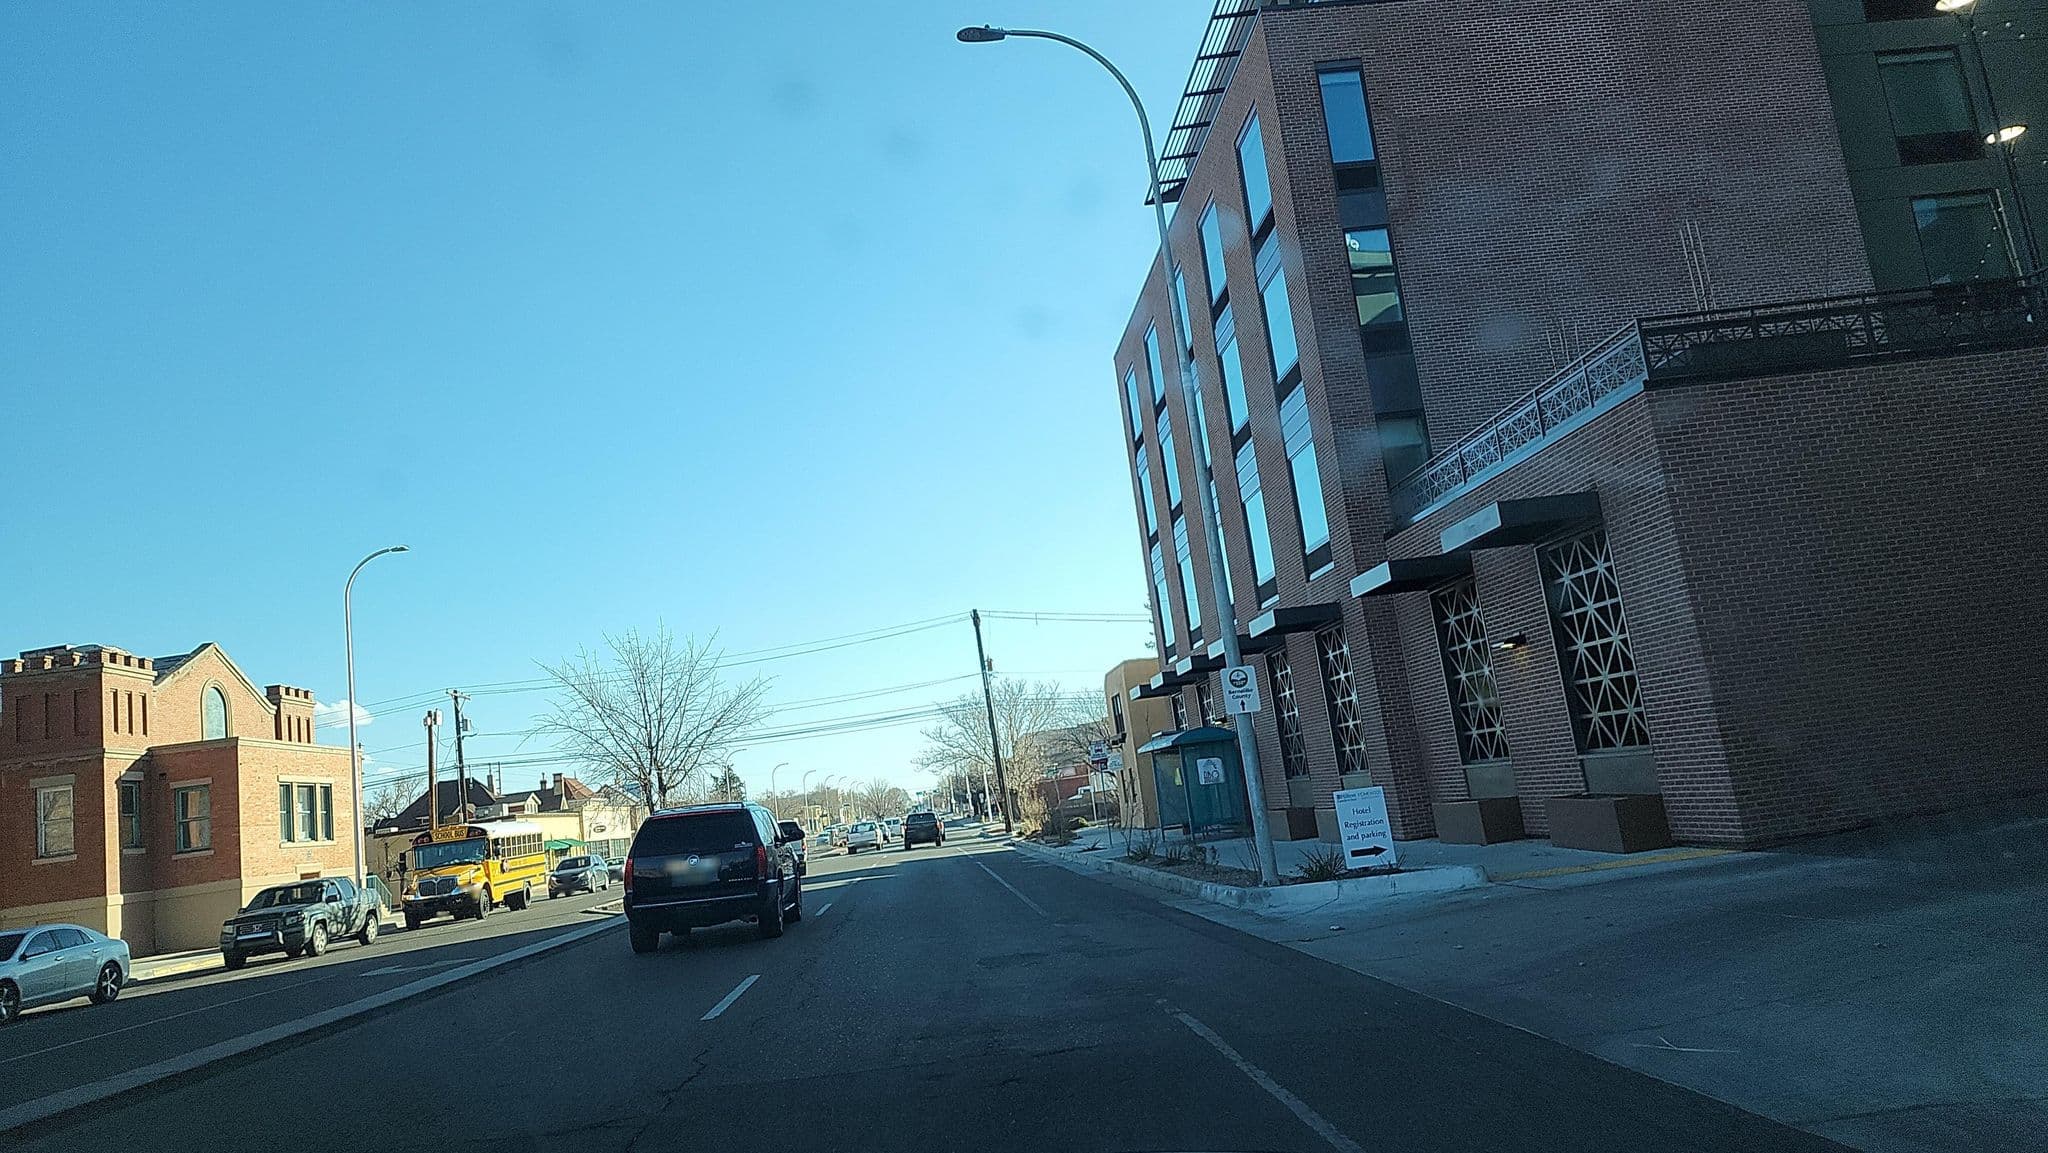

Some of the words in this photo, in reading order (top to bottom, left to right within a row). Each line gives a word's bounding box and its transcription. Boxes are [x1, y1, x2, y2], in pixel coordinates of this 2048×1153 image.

[1352, 806, 1371, 815] Hotel
[1344, 819, 1384, 829] Registration
[433, 830, 454, 841] SCHOOL
[454, 829, 465, 838] BUS
[1346, 832, 1360, 841] and
[1360, 831, 1388, 841] parking
